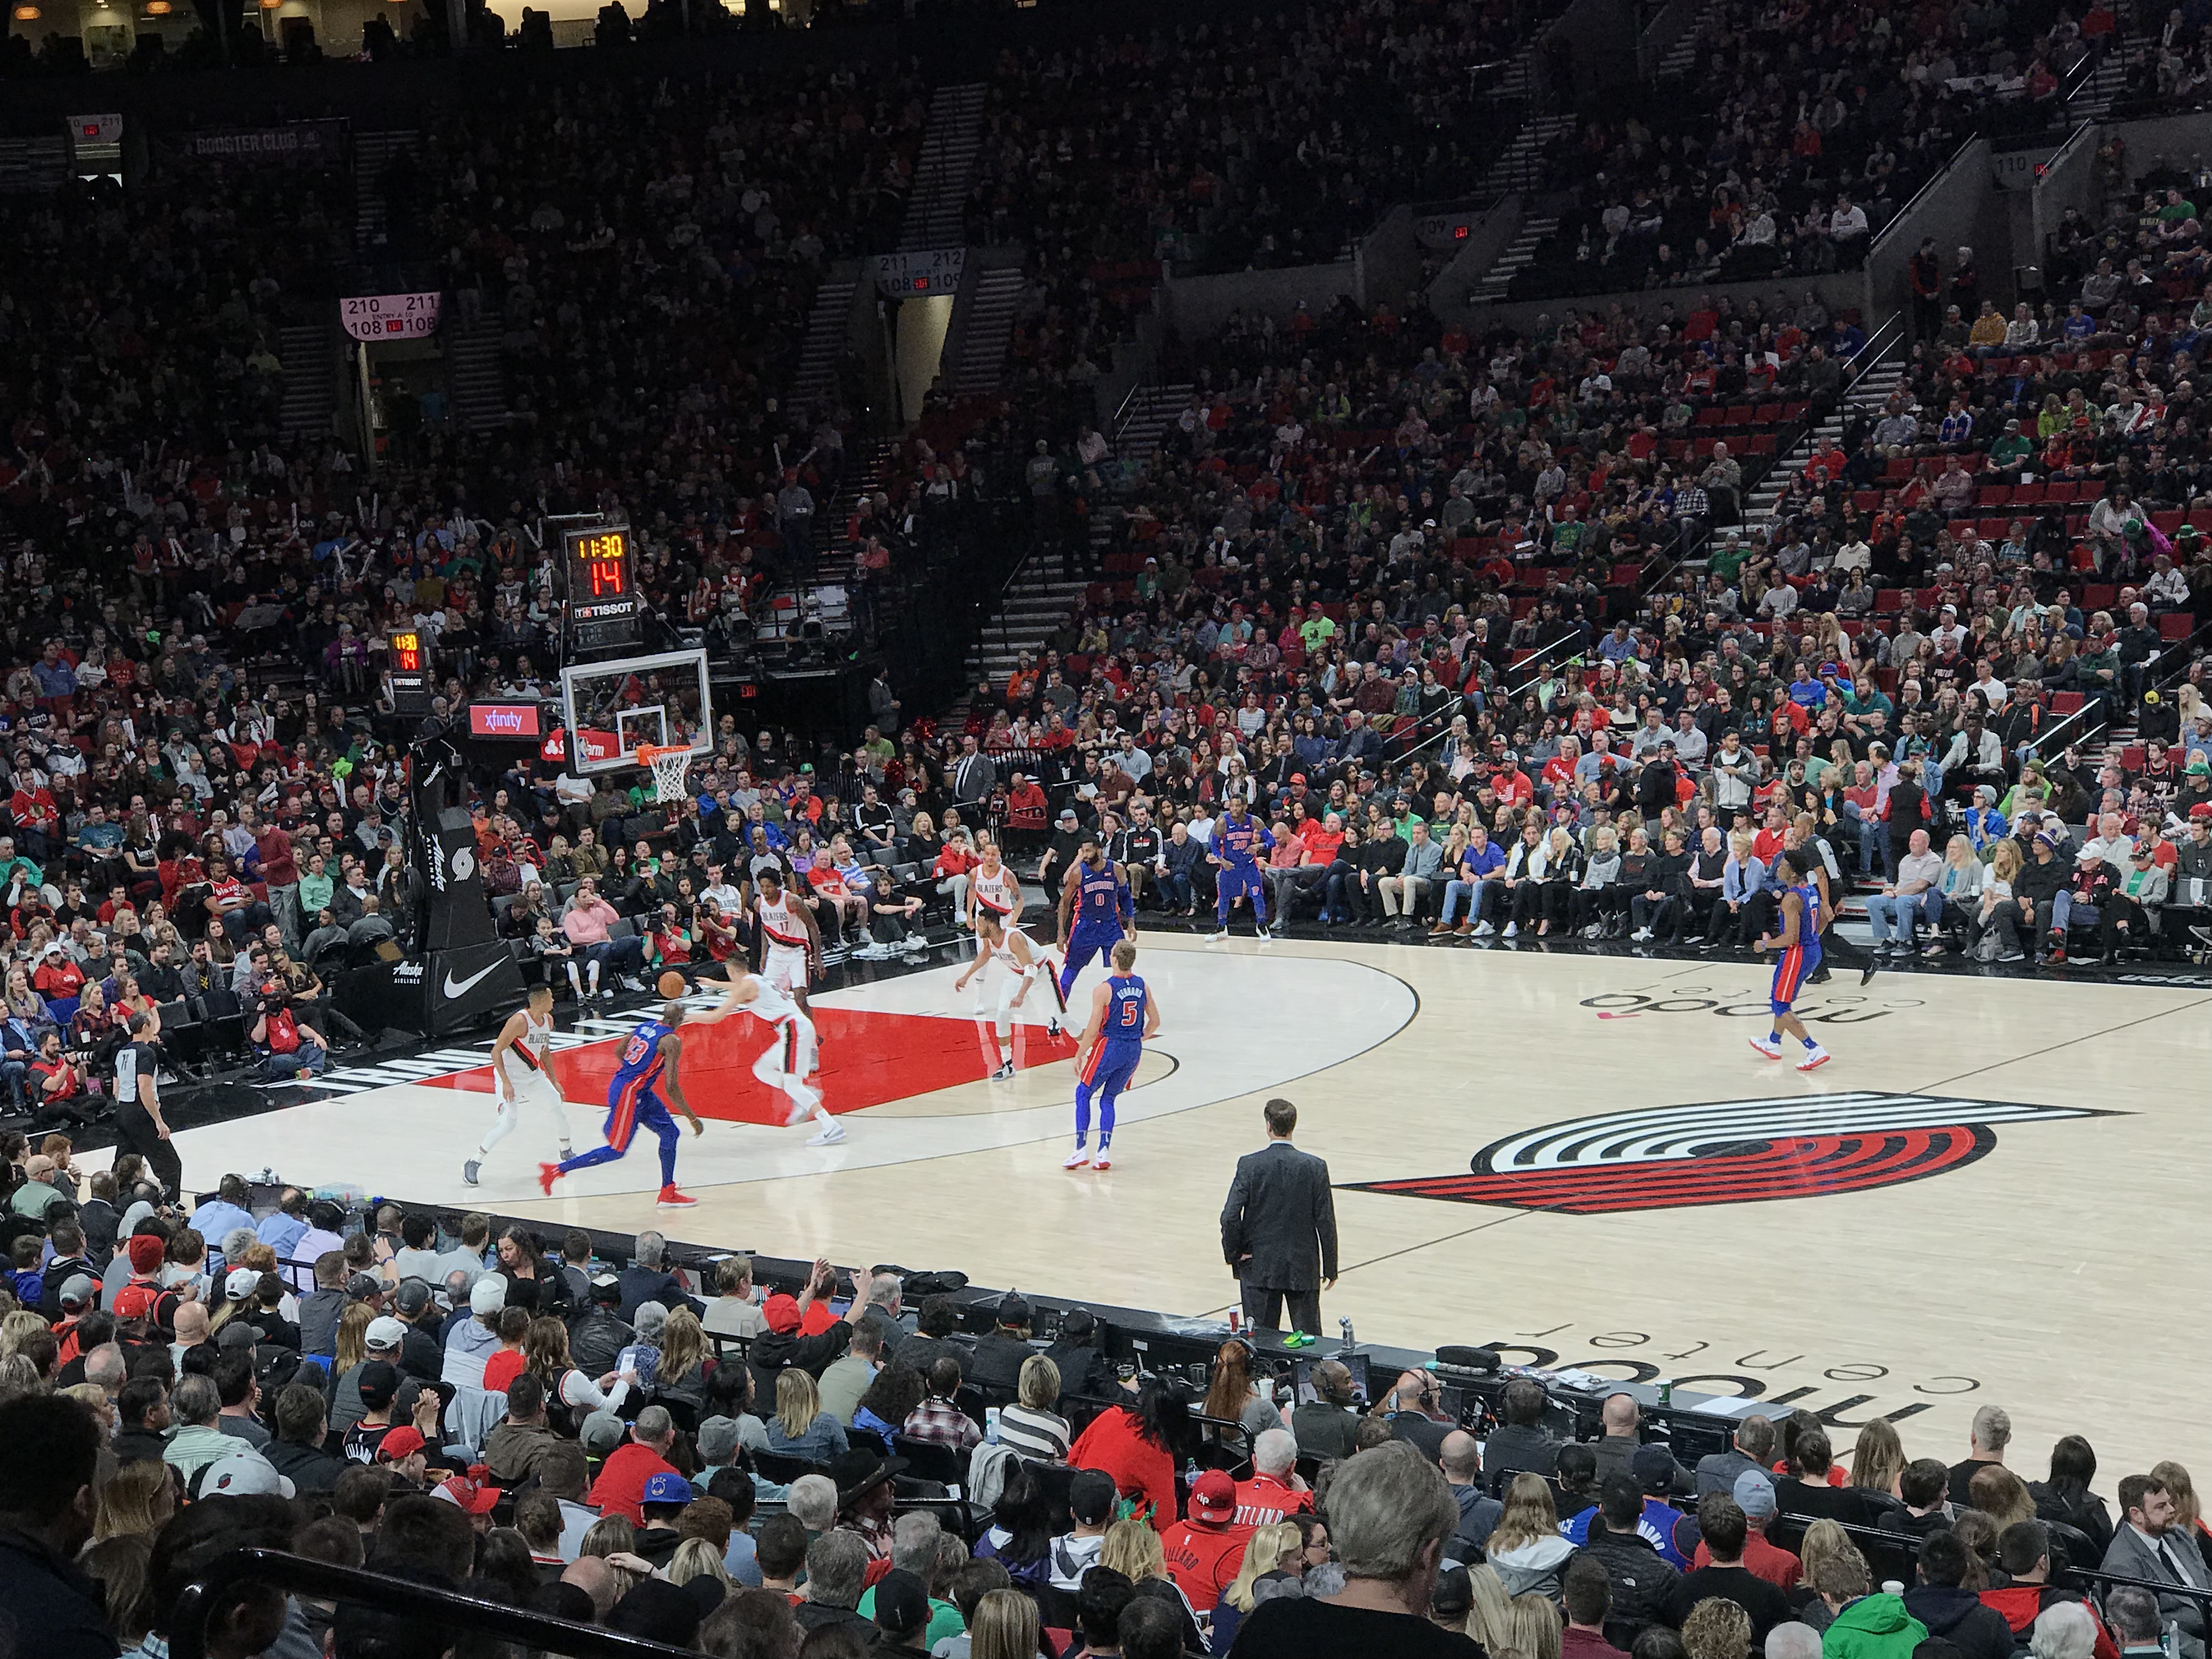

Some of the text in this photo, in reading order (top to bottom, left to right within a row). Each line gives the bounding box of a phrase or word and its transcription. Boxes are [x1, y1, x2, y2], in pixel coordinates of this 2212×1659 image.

[881, 251, 961, 270] 211 212
[349, 295, 435, 314] 210 211
[351, 320, 381, 334] 108
[406, 317, 436, 332] 108
[579, 535, 623, 558] 11:30
[591, 561, 622, 596] 14
[591, 602, 633, 617] TISSOT
[396, 635, 417, 651] 11:30
[403, 651, 415, 669] 14
[484, 709, 522, 731] xfinity
[587, 743, 604, 757] arm
[431, 833, 447, 893] Alaska
[761, 911, 788, 921] BLAZERS
[779, 921, 789, 932] 17
[63, 974, 77, 983] city
[392, 961, 424, 978] Alaska
[1121, 1001, 1138, 1026] 5
[1515, 1323, 1982, 1395] center
[1197, 1492, 1210, 1506] rip
[1233, 1505, 1284, 1527] RTLAND
